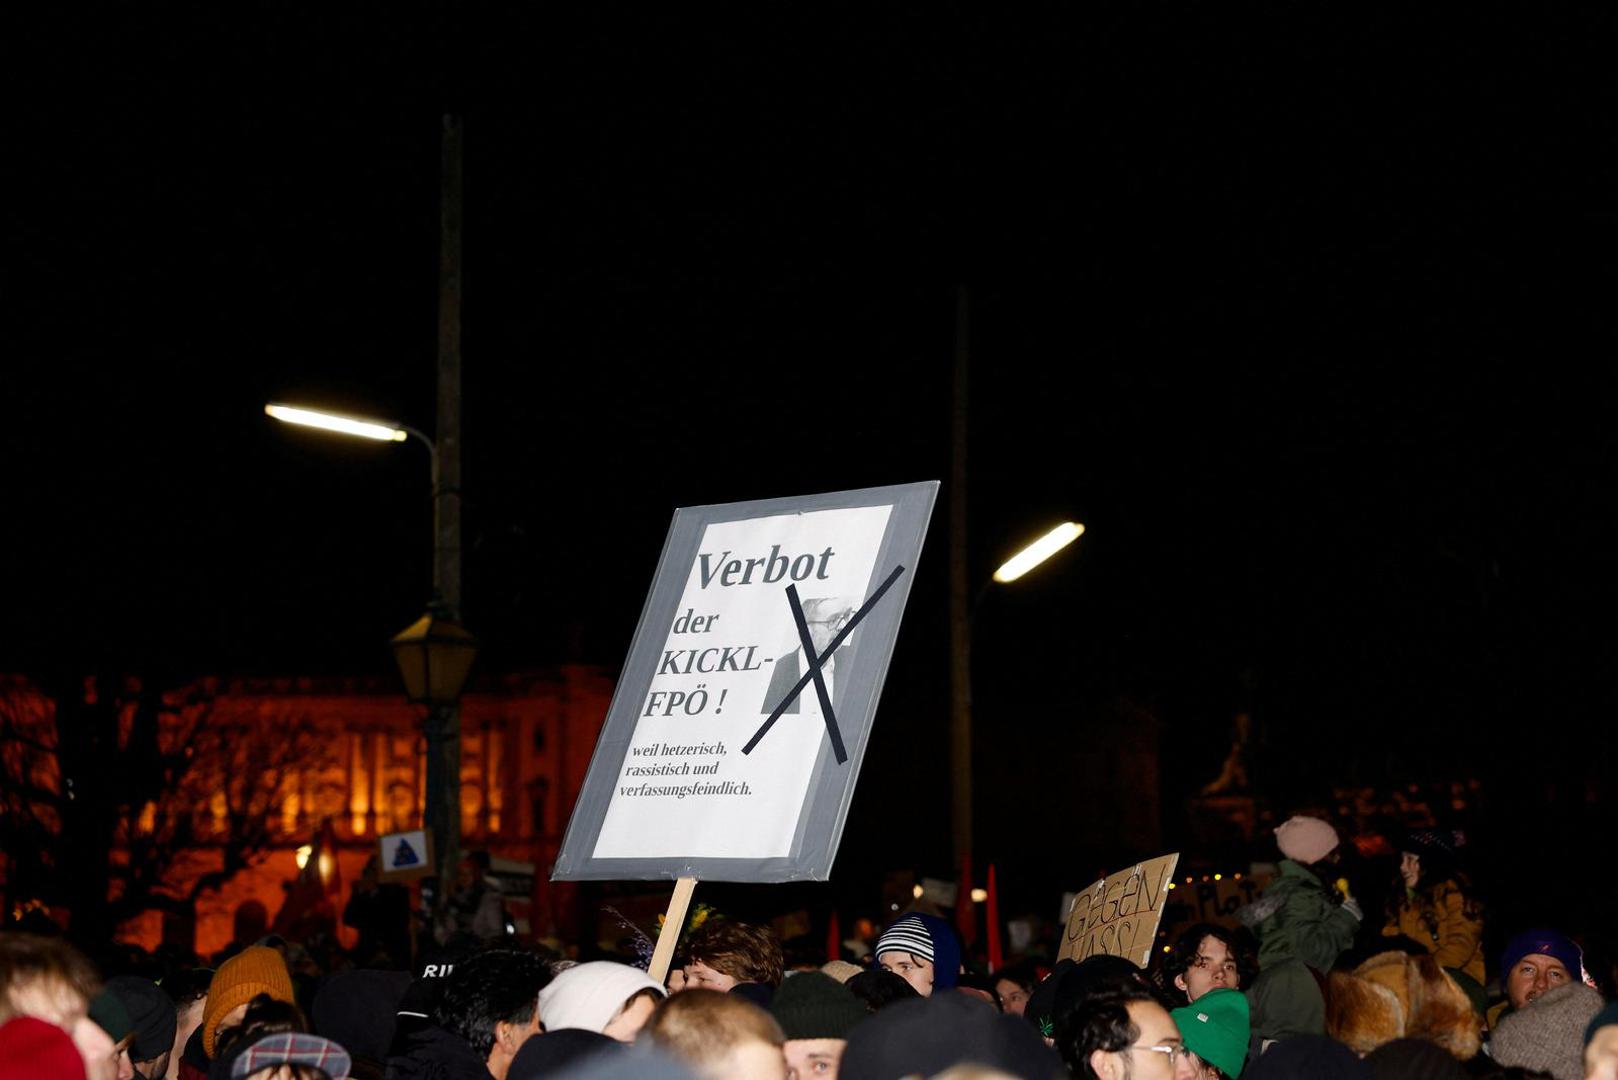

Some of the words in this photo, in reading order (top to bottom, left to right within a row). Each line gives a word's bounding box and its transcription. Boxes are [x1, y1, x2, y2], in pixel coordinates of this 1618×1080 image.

[698, 544, 835, 590] Verbot
[673, 608, 719, 635] der
[657, 645, 774, 676] KICKL-
[643, 684, 708, 717] FPÖ
[715, 689, 728, 715] !
[633, 743, 659, 757] weil
[661, 741, 728, 757] hetzerisch,
[625, 761, 691, 777] rassistisch
[693, 760, 719, 776] und
[620, 781, 753, 799] verfassungsfeindlich.
[1067, 863, 1167, 941] GEGEN
